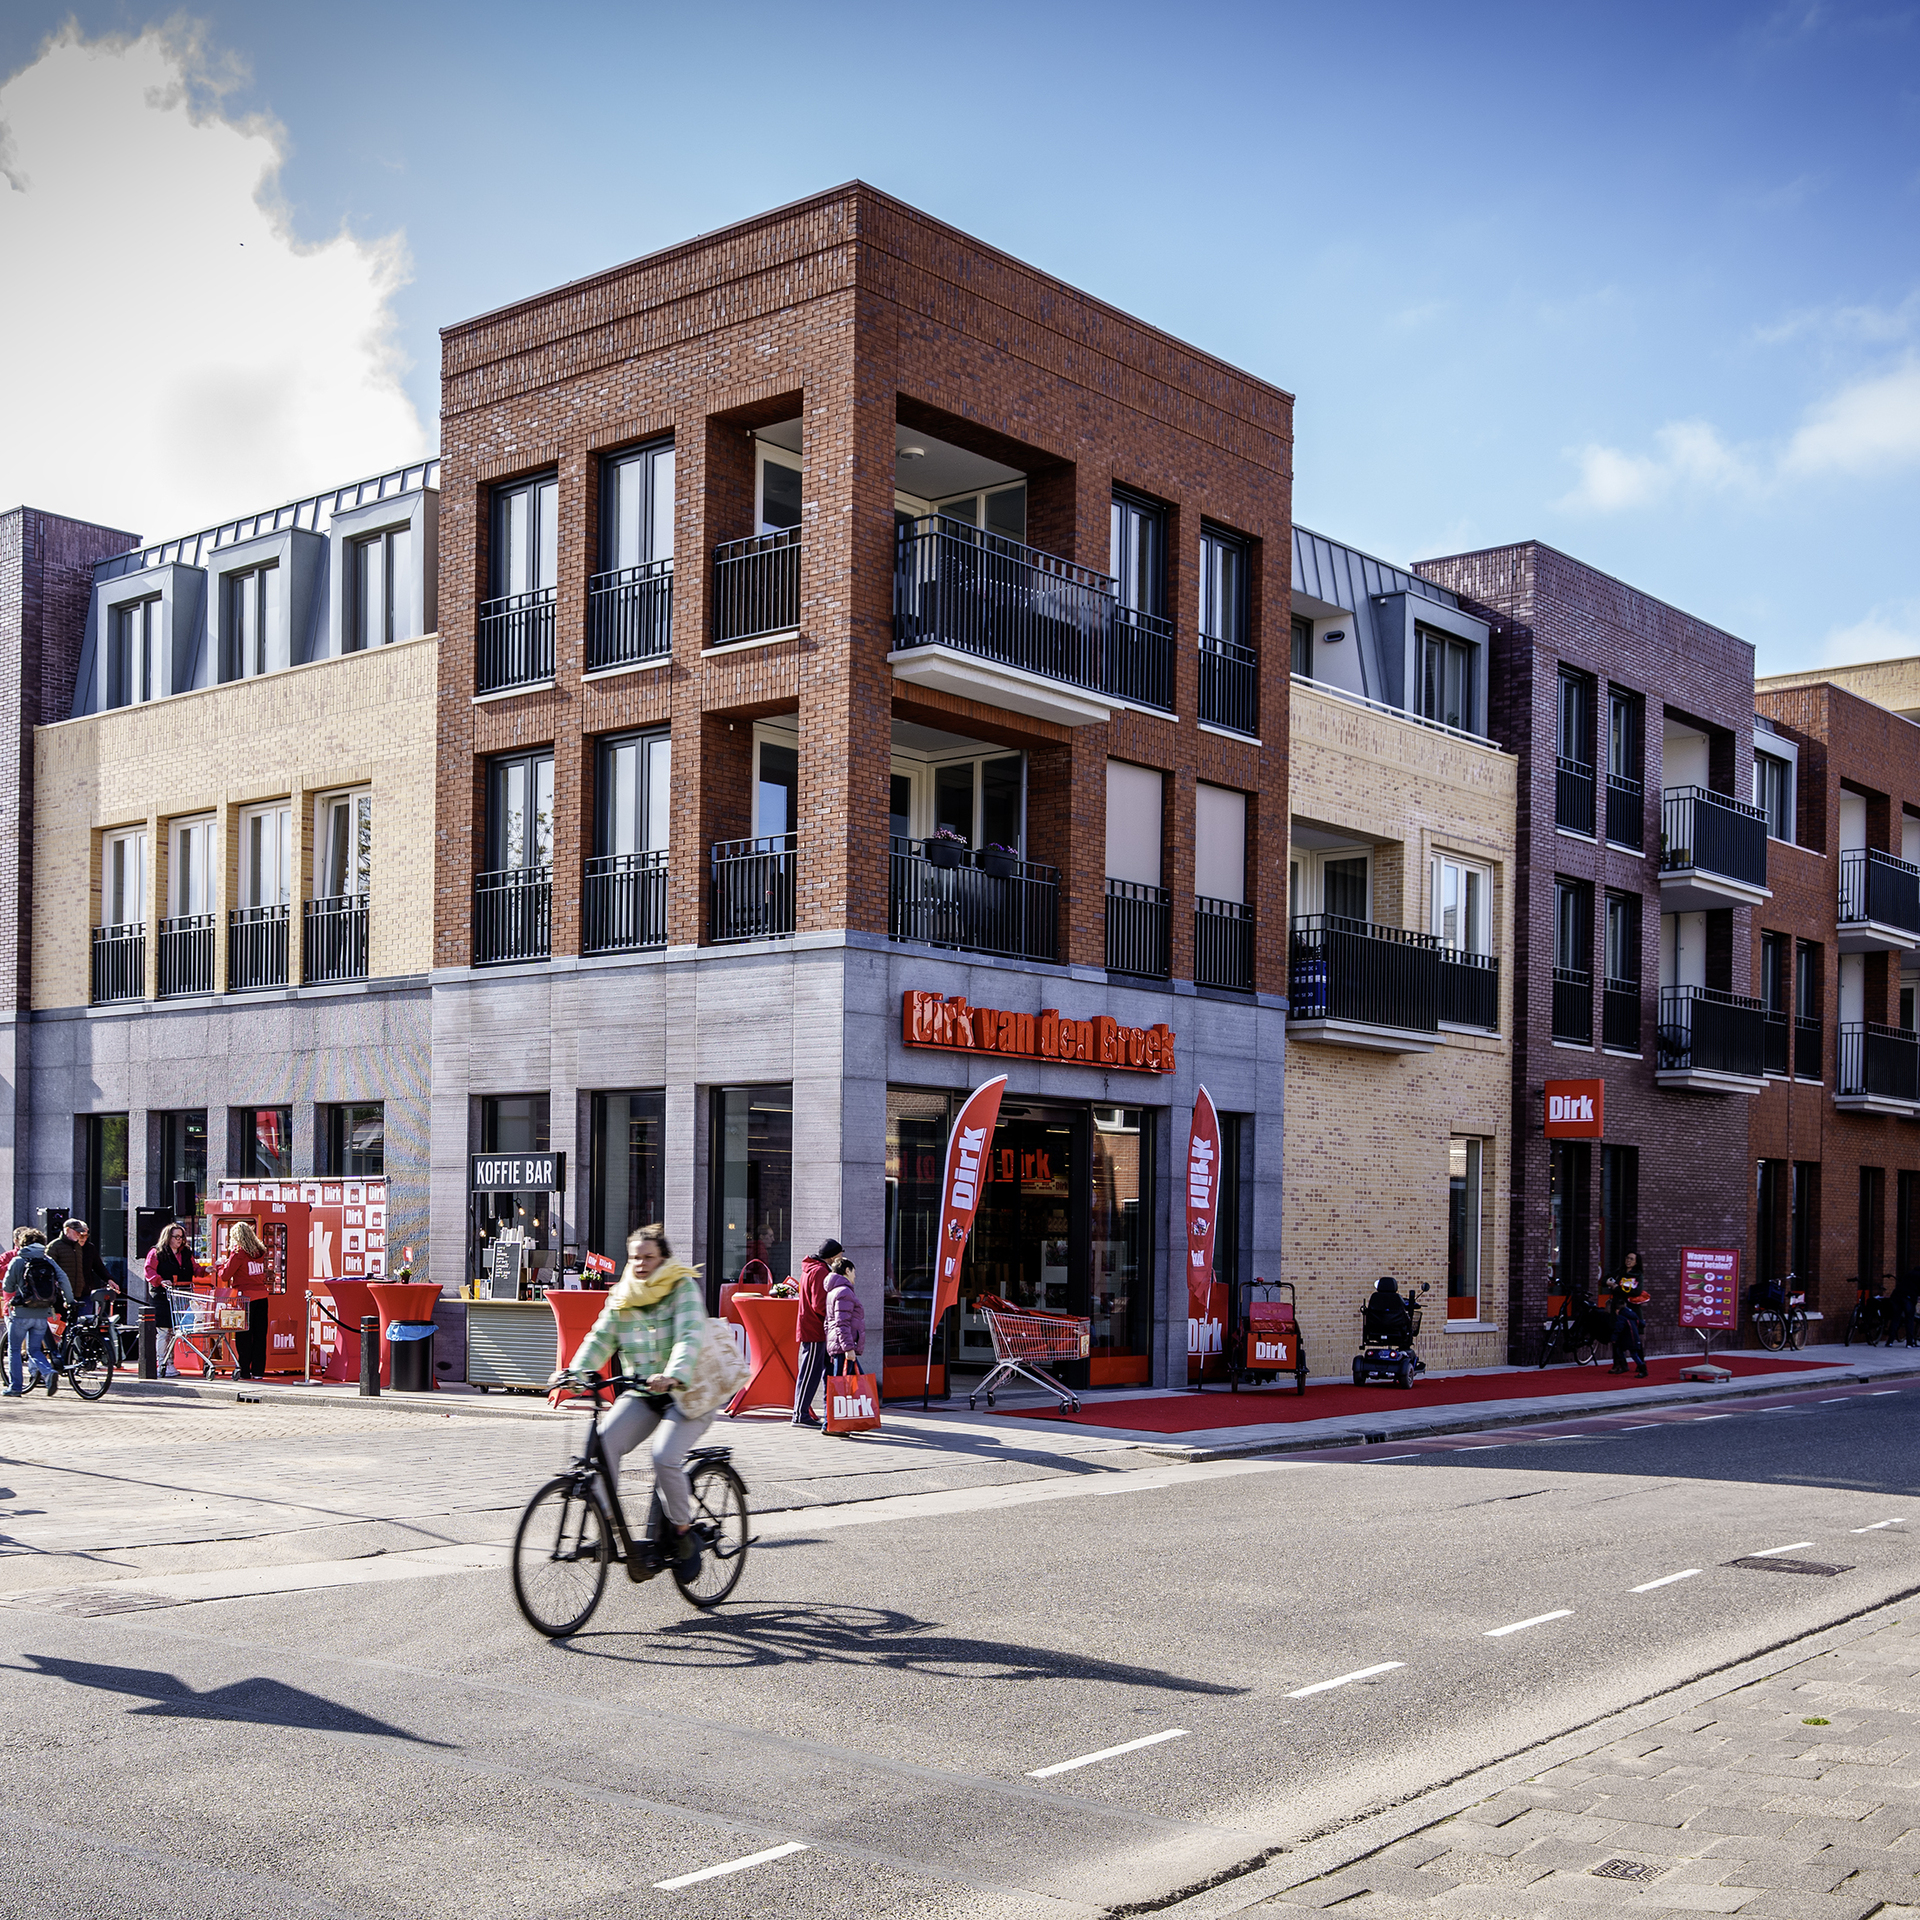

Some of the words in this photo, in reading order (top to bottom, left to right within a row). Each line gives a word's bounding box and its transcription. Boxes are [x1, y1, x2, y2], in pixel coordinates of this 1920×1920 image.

[904, 989, 975, 1047] Dirk
[975, 1008, 1035, 1055] van
[1036, 1009, 1094, 1061] den
[1094, 1015, 1177, 1070] Broek
[1549, 1094, 1595, 1120] Dirk
[476, 1160, 521, 1185] KOFFIE
[525, 1160, 553, 1184] BAR
[951, 1126, 987, 1211] Dirk
[1001, 1148, 1051, 1179] Dirk
[282, 1186, 298, 1202] Dirk
[324, 1185, 342, 1201] Dirk
[368, 1185, 386, 1201] Dirk
[272, 1202, 287, 1213] Dirk
[345, 1208, 364, 1225] Dirk
[345, 1256, 363, 1271] Dirk
[273, 1333, 295, 1349] Dirk
[1187, 1317, 1223, 1353] Dirk
[1255, 1341, 1288, 1360] Dirk
[833, 1394, 875, 1420] Dirk
